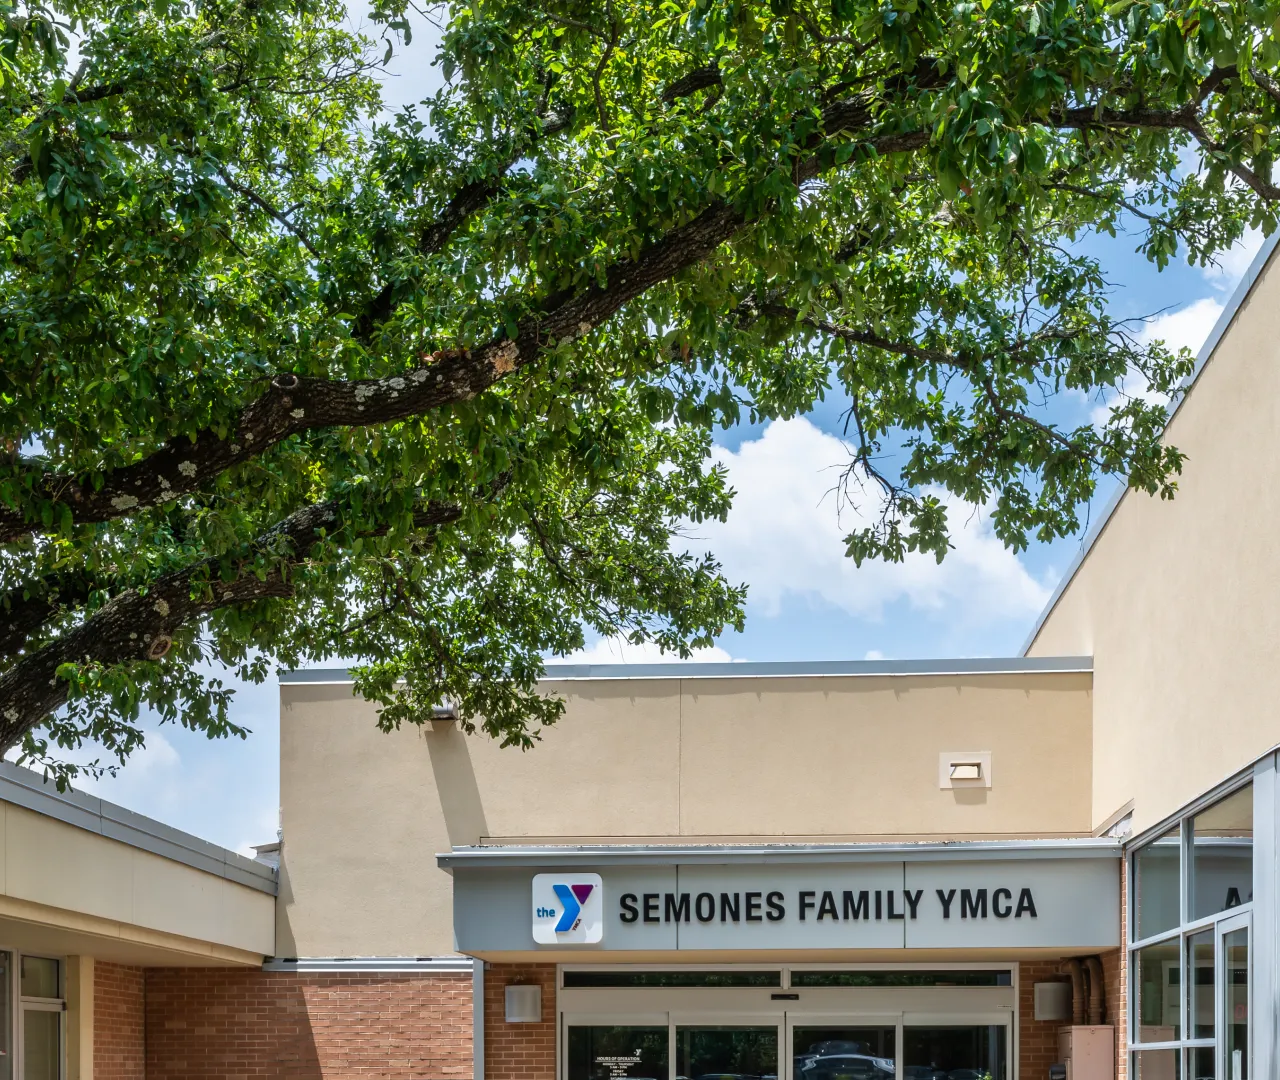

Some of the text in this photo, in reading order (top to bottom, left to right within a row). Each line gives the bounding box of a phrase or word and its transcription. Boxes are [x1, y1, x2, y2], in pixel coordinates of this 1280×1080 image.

[536, 906, 556, 918] the
[619, 888, 1038, 923] SEMONES FAMILY YMCA
[572, 918, 582, 931] YMCA
